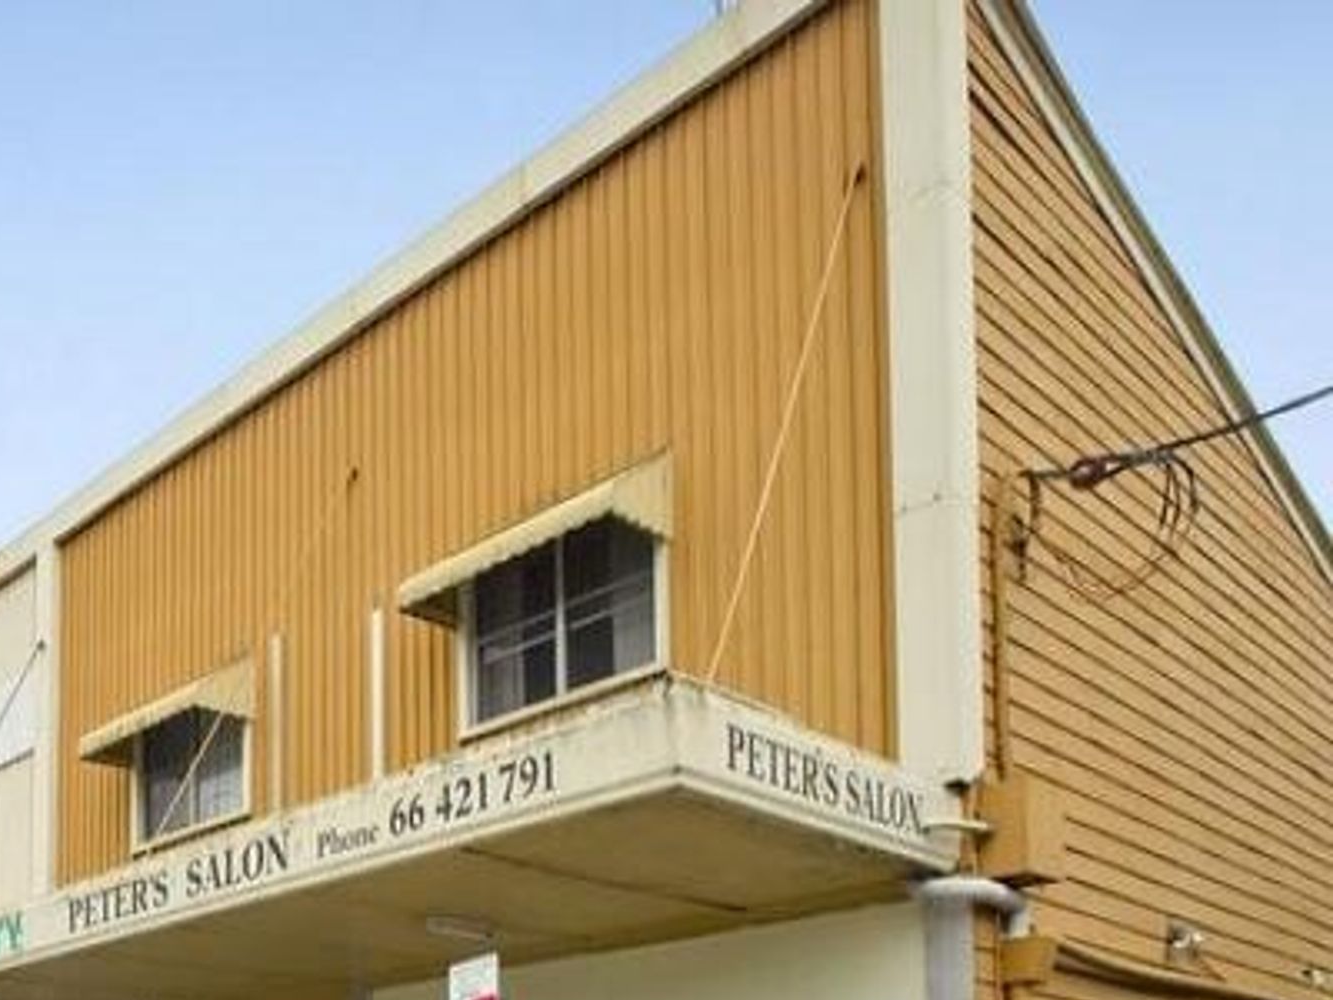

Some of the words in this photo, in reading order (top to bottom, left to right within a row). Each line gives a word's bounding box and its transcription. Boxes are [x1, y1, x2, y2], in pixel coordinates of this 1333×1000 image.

[727, 721, 840, 807] PETER'S
[68, 869, 170, 933] PETER'S
[185, 829, 291, 898] SALON
[316, 825, 380, 858] Phone
[389, 795, 425, 838] 66
[435, 771, 489, 823] 421
[498, 750, 555, 803] 791
